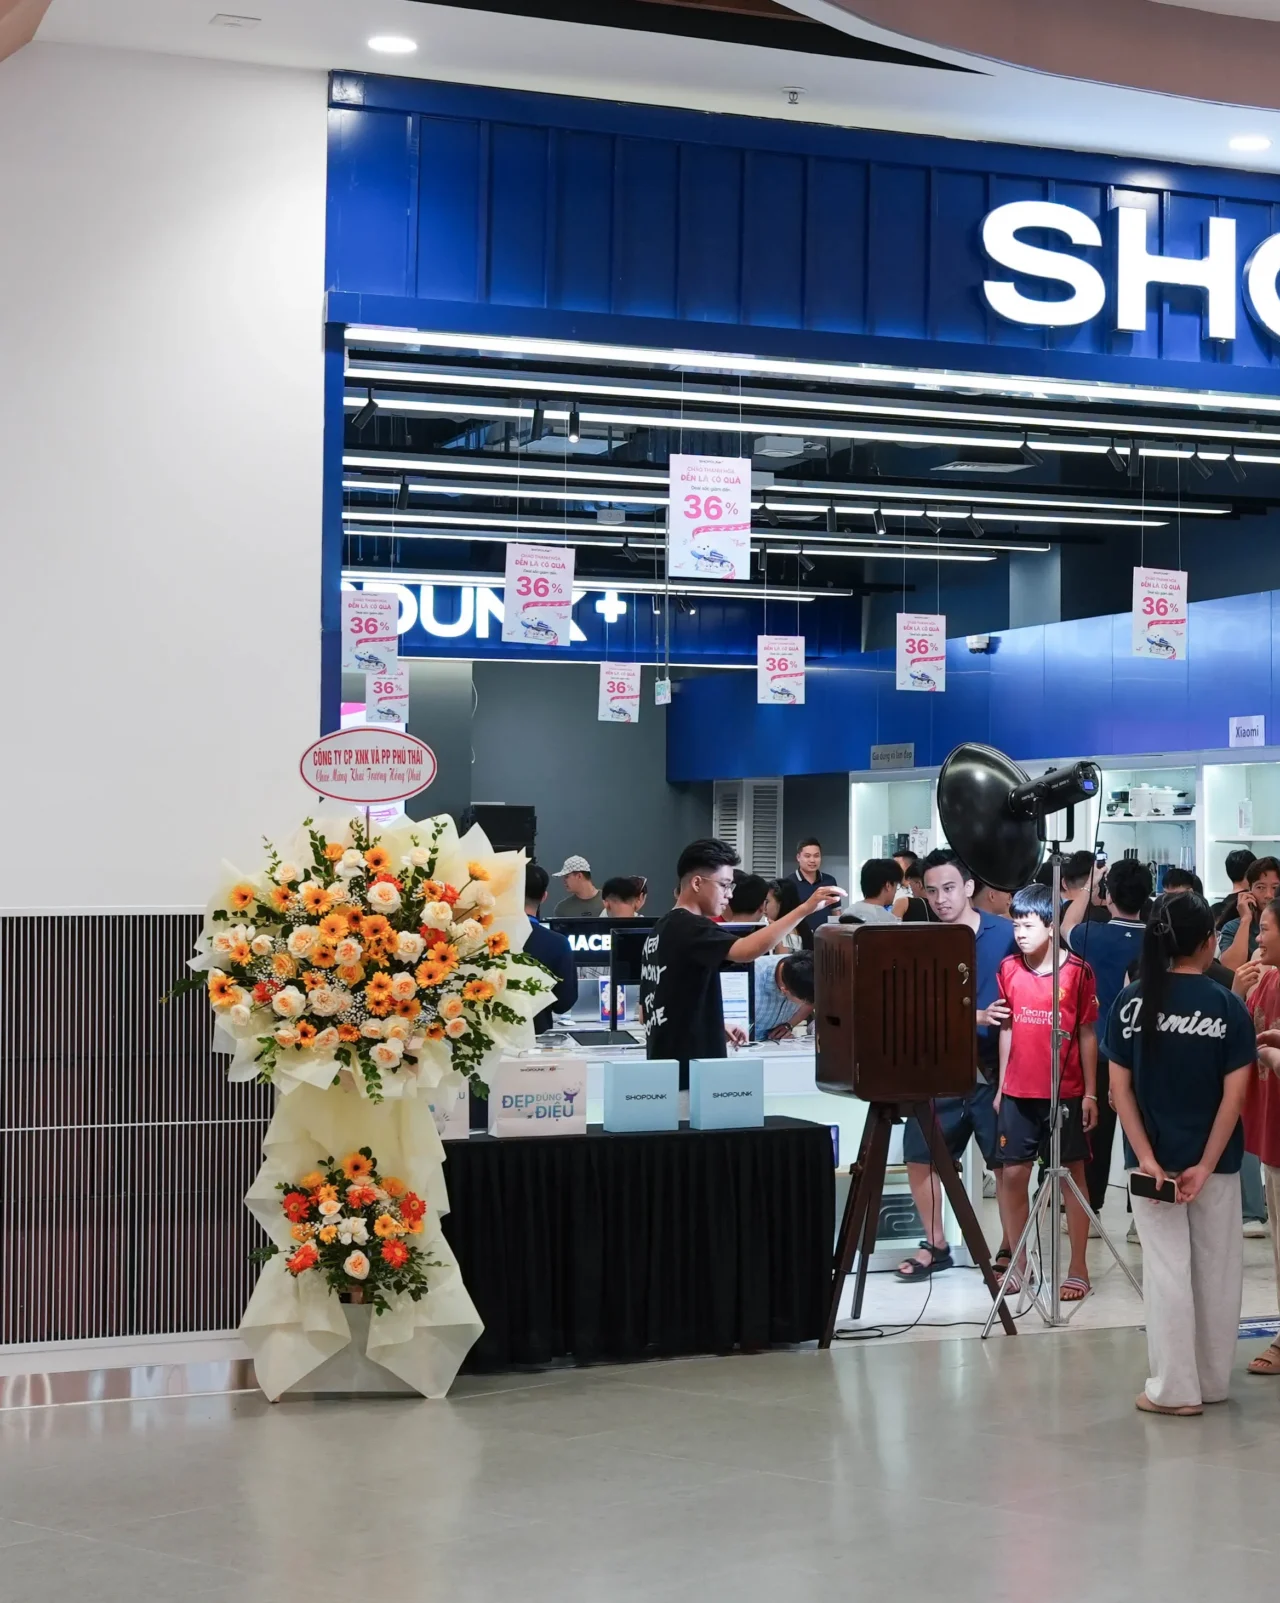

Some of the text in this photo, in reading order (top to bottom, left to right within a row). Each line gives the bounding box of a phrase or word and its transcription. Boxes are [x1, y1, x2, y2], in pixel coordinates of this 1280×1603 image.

[683, 494, 739, 521] 36%
[516, 576, 563, 597] 36%
[1142, 596, 1179, 617] 36%
[350, 616, 389, 634] 36%
[905, 638, 938, 654] 36%
[1235, 724, 1259, 738] Xiaomi
[313, 747, 332, 766] CÔNG
[333, 750, 343, 764] TY
[343, 749, 353, 765] CP
[354, 749, 369, 765] XNK
[381, 749, 391, 765] PP
[1013, 1013, 1048, 1025] Viewer
[1021, 1006, 1047, 1017] Team
[502, 1092, 562, 1111] ĐẸP ĐÚNG
[712, 1090, 753, 1098] SHOPDUNK
[535, 1101, 574, 1121] ĐIỆU
